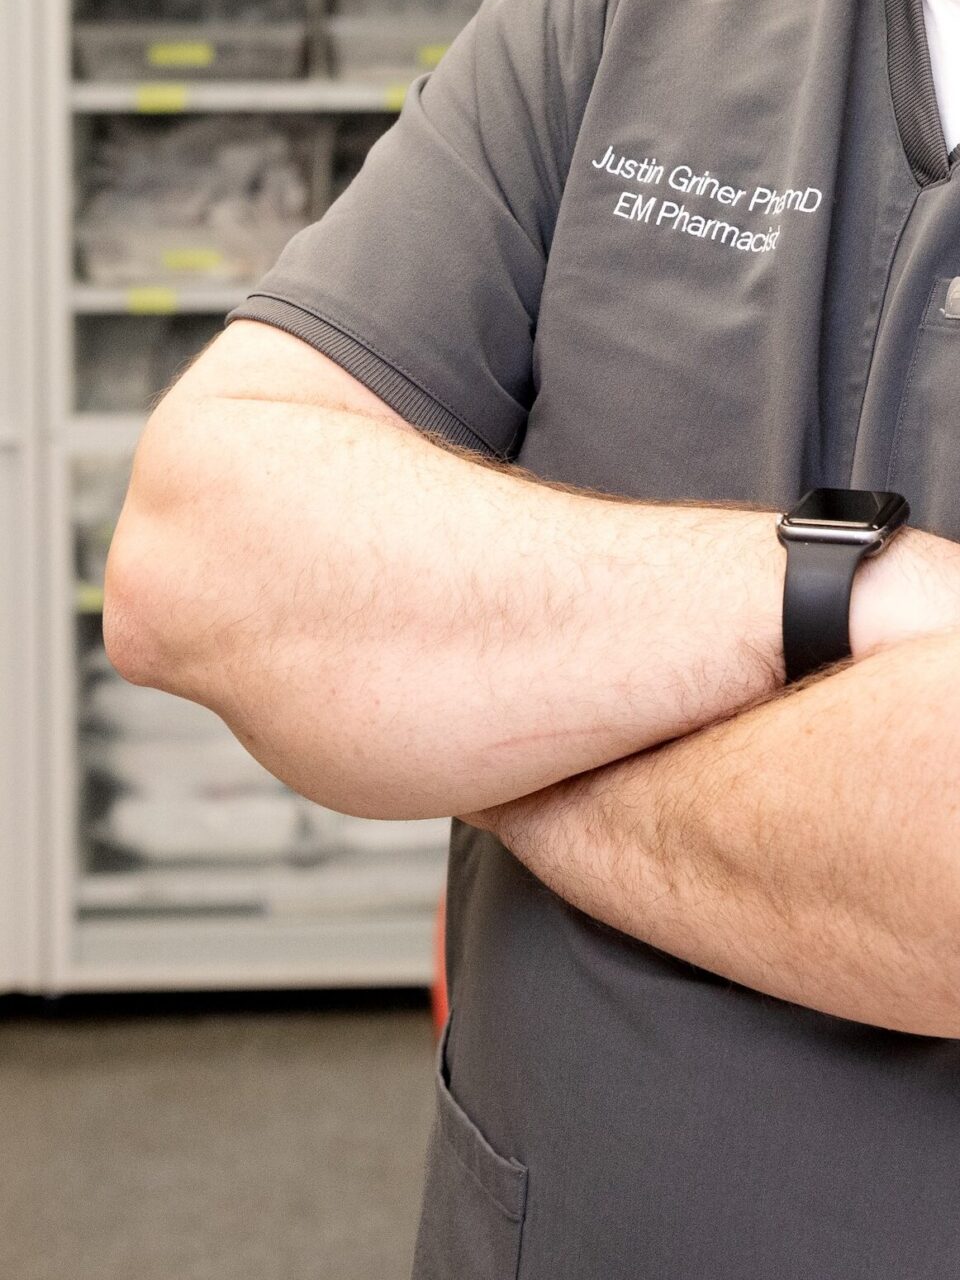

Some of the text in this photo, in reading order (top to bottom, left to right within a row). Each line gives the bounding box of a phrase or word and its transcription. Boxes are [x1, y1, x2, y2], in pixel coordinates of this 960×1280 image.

[592, 145, 822, 215] Justin Griner PhamD
[613, 192, 657, 223] EM
